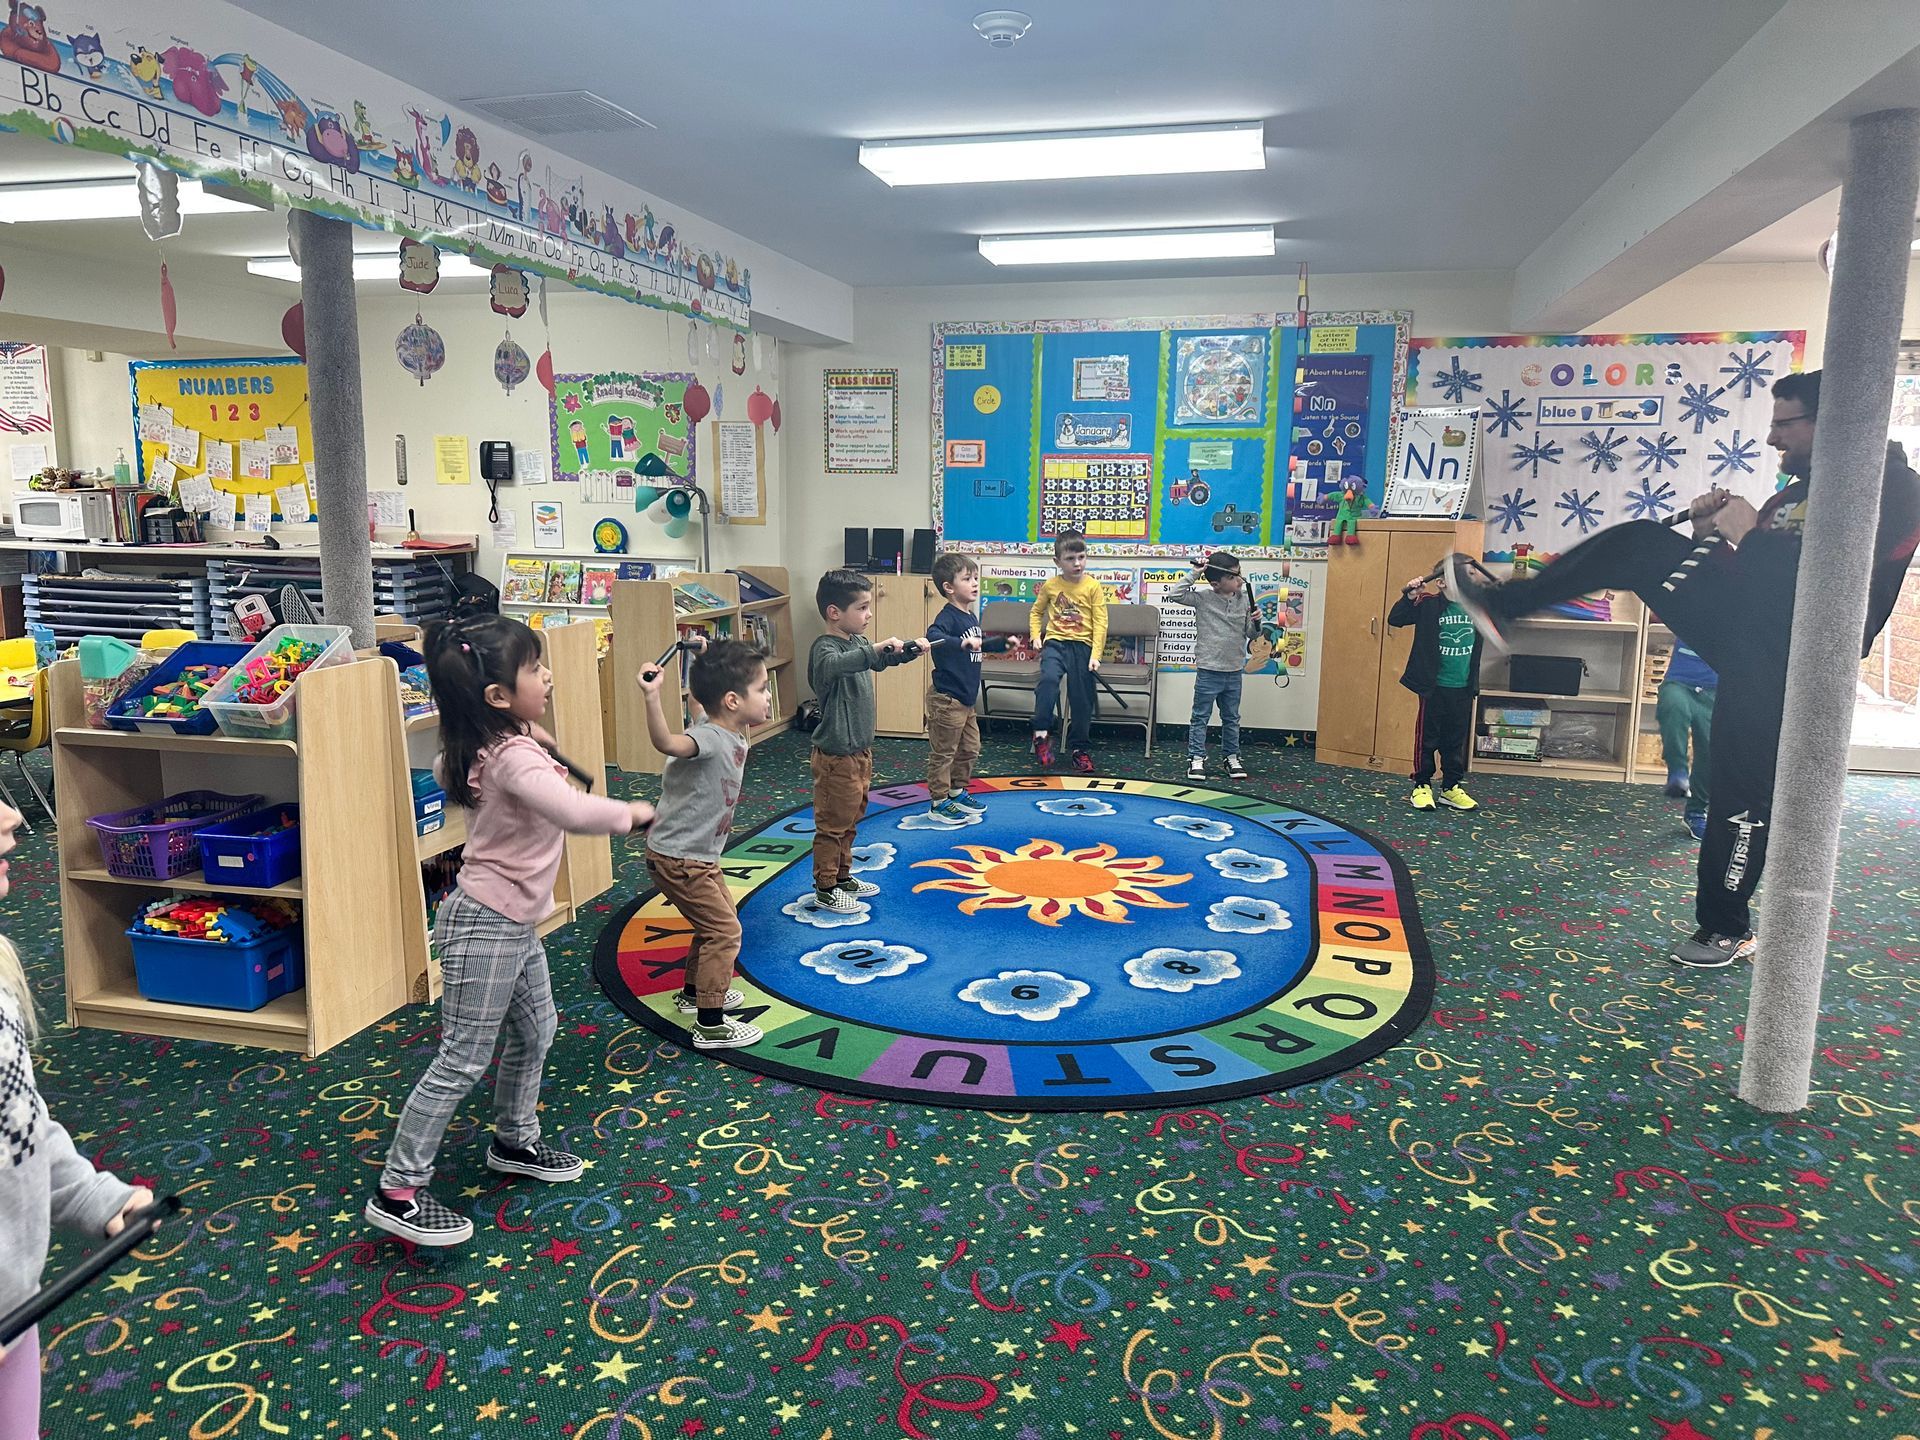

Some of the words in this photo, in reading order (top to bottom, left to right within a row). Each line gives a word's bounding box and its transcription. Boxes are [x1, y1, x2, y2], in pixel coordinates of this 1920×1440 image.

[20, 66, 62, 113] Bb
[80, 88, 121, 129] Cc
[136, 102, 171, 146] Dd
[193, 121, 222, 159] Ee
[238, 135, 260, 172] Ff
[283, 151, 314, 200] Gg
[329, 164, 355, 199] Hh
[368, 177, 381, 207] Ii
[401, 188, 418, 229] Jj
[433, 198, 453, 228] Kk
[466, 209, 479, 236] Ll
[488, 222, 515, 248] Mm
[519, 226, 538, 254] Nn
[543, 235, 562, 261] Oo
[571, 243, 585, 275] Pp
[589, 250, 606, 284] Qq
[611, 256, 623, 279] Rr
[629, 263, 639, 285] Ss
[666, 273, 677, 296] Uu
[684, 279, 693, 300] Vv
[714, 292, 726, 313] Xx
[728, 297, 737, 323] Yy
[406, 256, 430, 270] Jude
[498, 283, 519, 296] Luca
[1309, 368, 1330, 376] About
[1331, 368, 1343, 376] the
[1344, 368, 1367, 376] Letter:
[1520, 362, 1683, 387] COLORS
[178, 375, 275, 396] NUMBERS
[829, 376, 859, 386] CLASS
[862, 376, 892, 386] RULES
[595, 384, 623, 399] Reading
[625, 385, 650, 401] Garden
[976, 394, 996, 406] Circle
[1310, 395, 1337, 411] Nn
[209, 403, 218, 422] 1
[228, 403, 240, 422] 2
[248, 402, 260, 421] 3
[1340, 413, 1360, 421] Sound
[1541, 405, 1577, 418] blue
[1075, 424, 1113, 438] January
[1403, 441, 1460, 480] Nn
[1397, 489, 1423, 506] Nn
[1242, 514, 1252, 524] 12
[990, 567, 1027, 577] Numbers
[1113, 571, 1131, 581] Year
[1144, 572, 1165, 582] Days
[1167, 572, 1175, 580] of
[1249, 572, 1270, 582] Five
[982, 580, 988, 589] 1
[1019, 581, 1027, 591] 6
[982, 597, 988, 607] 2
[1160, 607, 1197, 617] Tuesday
[1160, 619, 1197, 628] ednesda
[1438, 614, 1474, 626] PHILL
[1158, 631, 1198, 640] Thursday
[1163, 642, 1192, 652] Friday
[1014, 651, 1026, 661] 10
[1157, 654, 1197, 664] Saturday
[1009, 779, 1048, 788] G
[1086, 780, 1127, 790] H
[879, 789, 918, 800] E
[1067, 803, 1085, 811] 4
[1221, 802, 1264, 811] J
[783, 822, 816, 834] C
[1183, 823, 1209, 831] 5
[1271, 818, 1319, 831] K
[744, 843, 795, 855] B
[1308, 840, 1352, 852] L
[722, 865, 767, 880] A
[1332, 863, 1385, 881] M
[1332, 892, 1386, 912] N
[1232, 910, 1266, 922] 7
[644, 925, 696, 943] Y
[1333, 921, 1391, 942] O
[1163, 961, 1201, 975] 8
[1331, 955, 1392, 977] P
[1293, 993, 1378, 1020] Q
[773, 1027, 840, 1060] V
[1229, 1023, 1316, 1056] R
[909, 1049, 988, 1085] U
[1149, 1045, 1217, 1077] S
[1043, 1053, 1112, 1086] T
